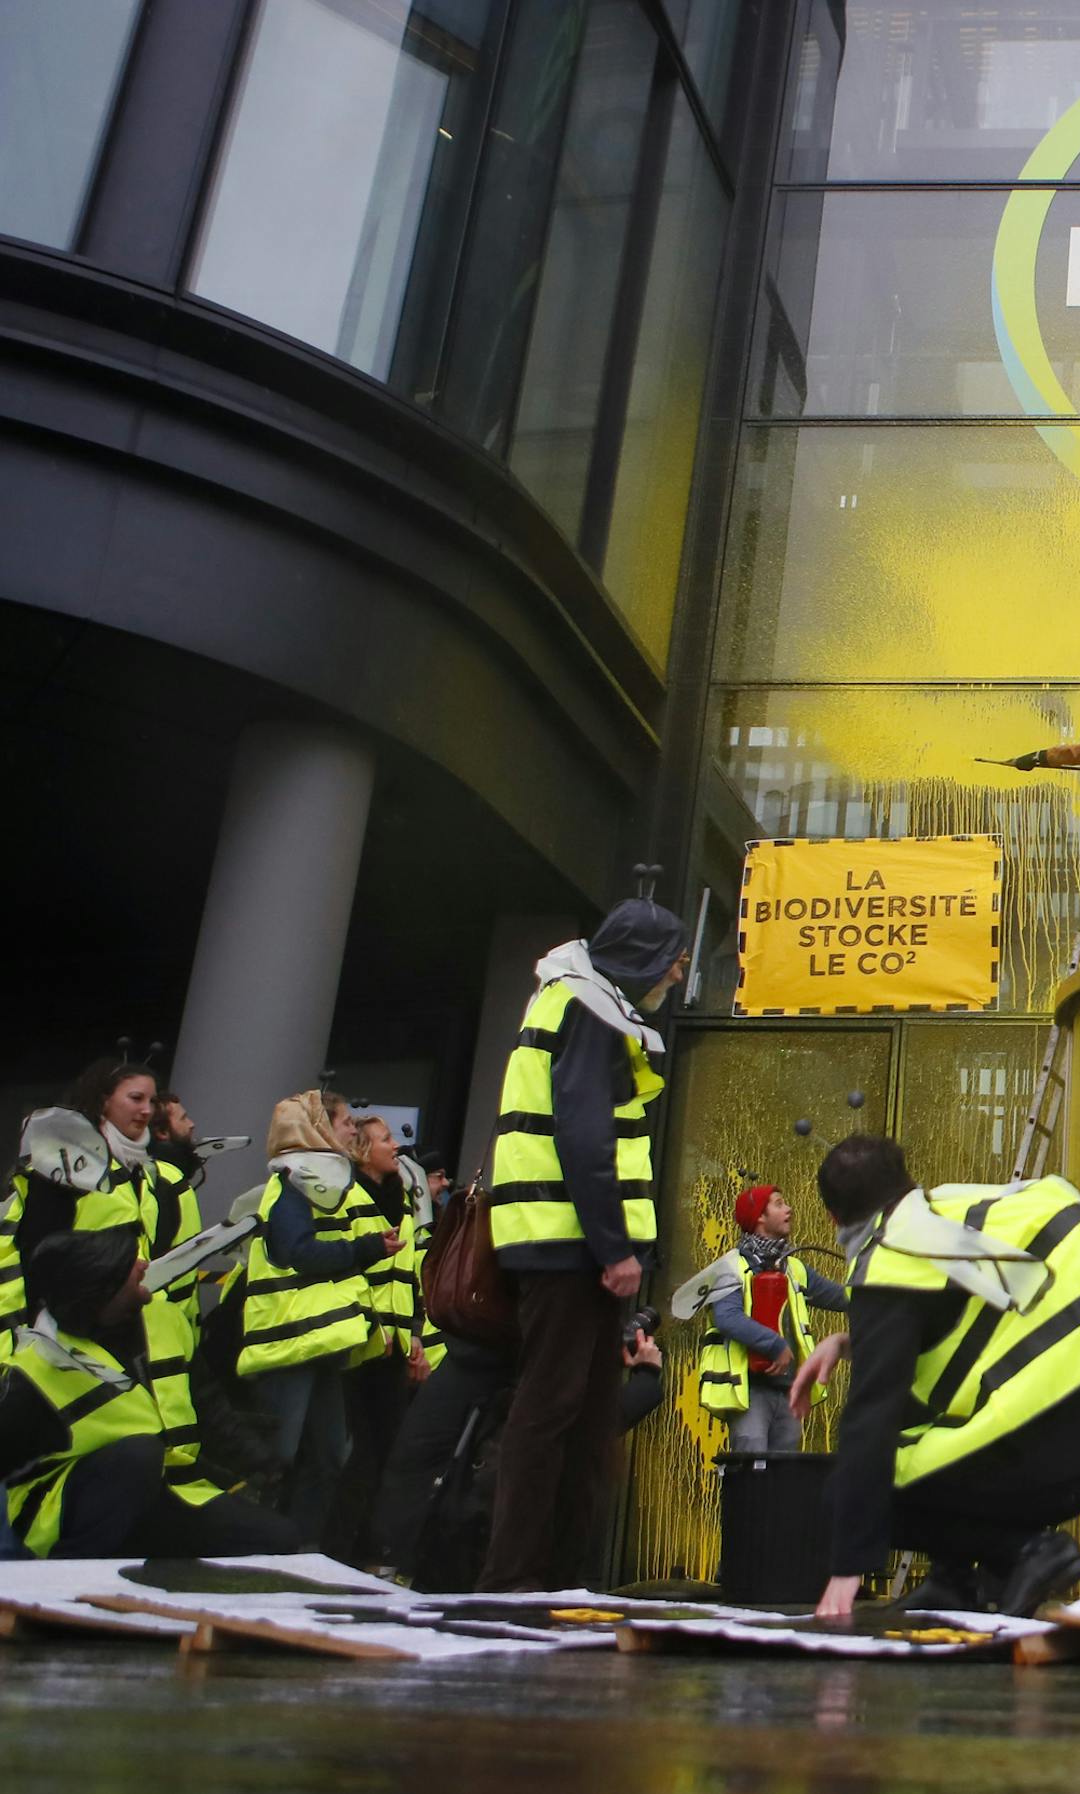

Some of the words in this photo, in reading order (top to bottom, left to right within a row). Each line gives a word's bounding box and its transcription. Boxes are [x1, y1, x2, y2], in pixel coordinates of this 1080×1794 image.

[846, 870, 886, 891] LA
[755, 888, 978, 923] BIODIVERSITÉ
[798, 924, 928, 947] STOCKE
[809, 954, 846, 976] LE
